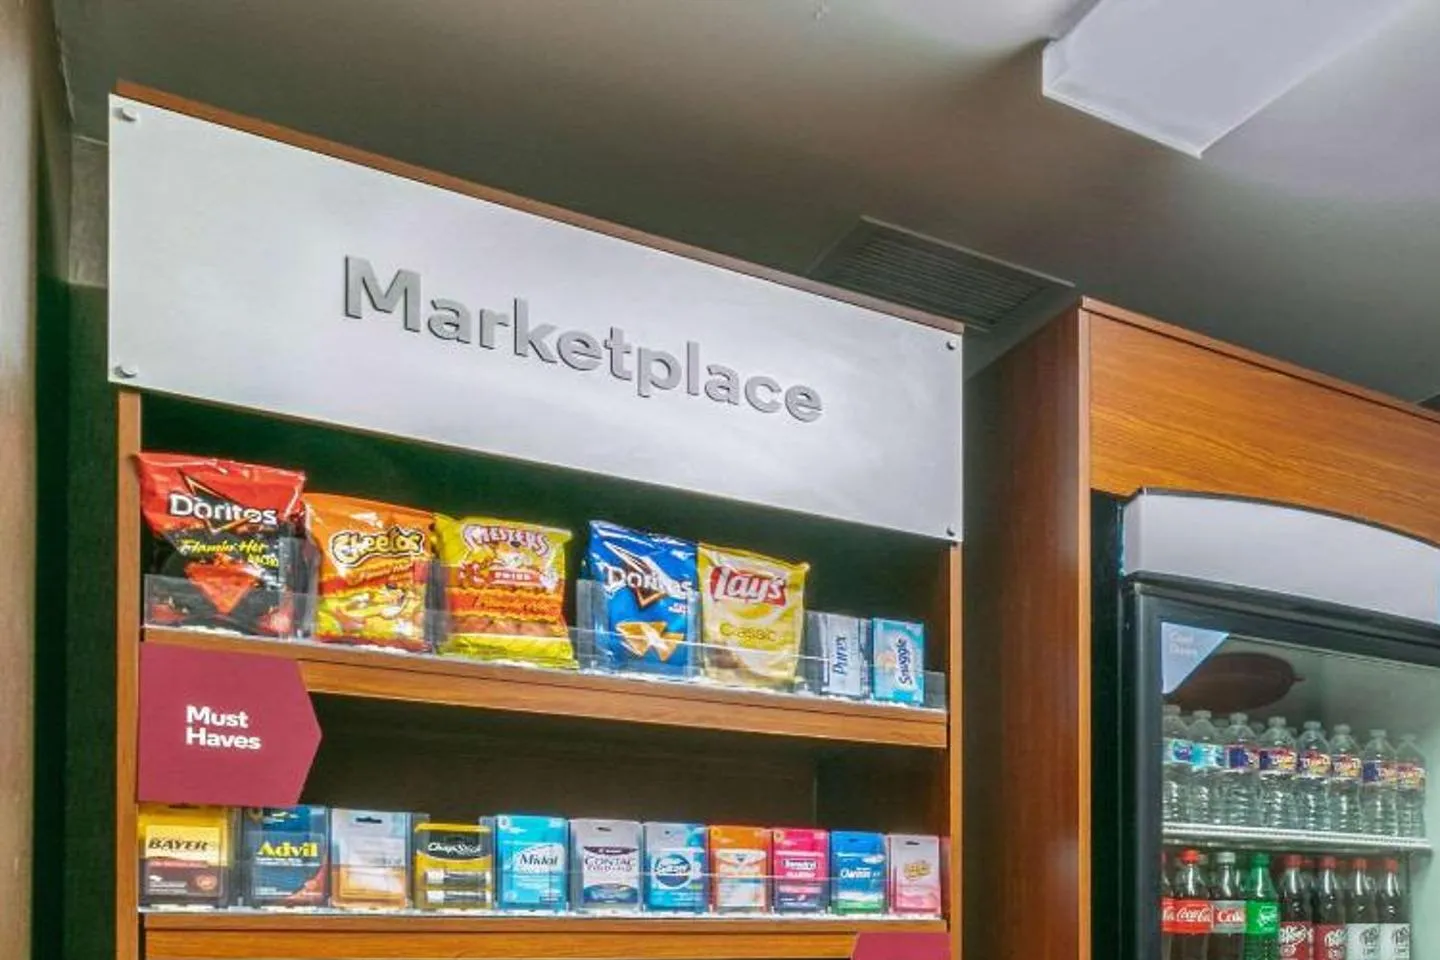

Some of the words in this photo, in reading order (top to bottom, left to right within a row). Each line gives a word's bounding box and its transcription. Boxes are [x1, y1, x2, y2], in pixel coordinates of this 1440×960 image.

[342, 254, 824, 424] Marketplace
[169, 492, 278, 526] Doritos
[711, 567, 785, 601] Lay's
[186, 705, 249, 728] Must
[186, 727, 262, 750] Haves
[148, 838, 209, 851] BAYER
[257, 841, 320, 858] Advil
[519, 853, 558, 866] Midol
